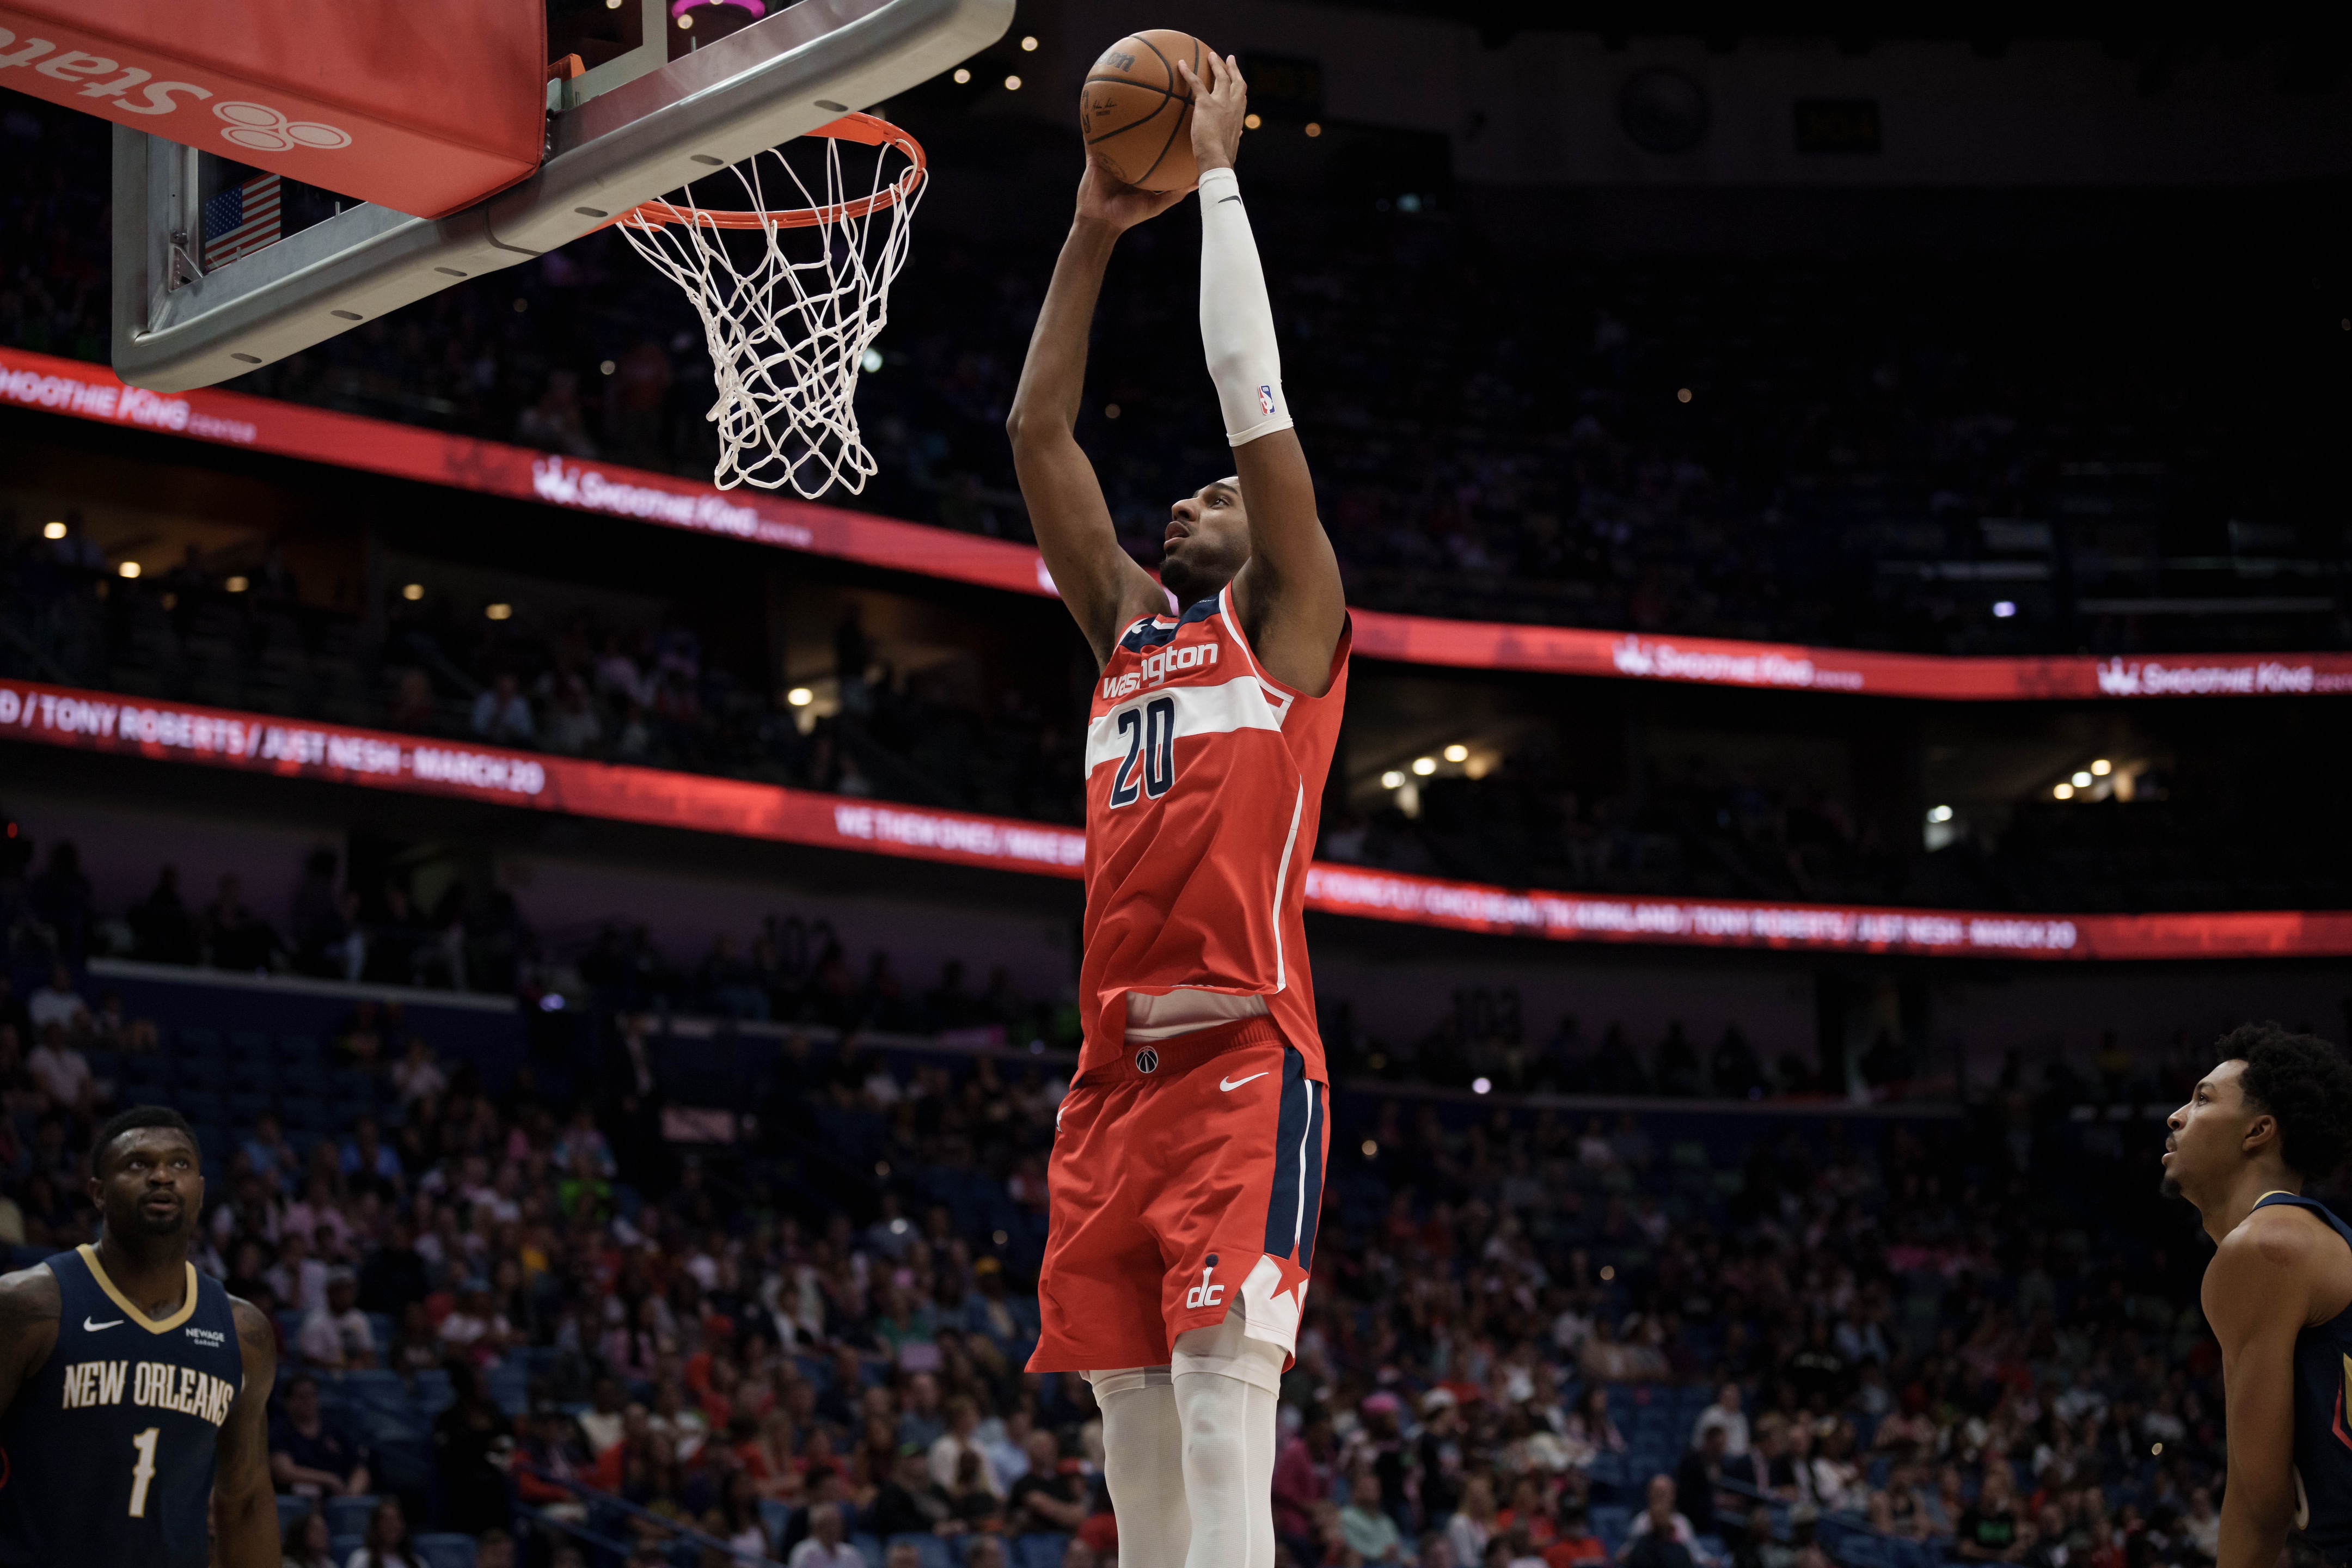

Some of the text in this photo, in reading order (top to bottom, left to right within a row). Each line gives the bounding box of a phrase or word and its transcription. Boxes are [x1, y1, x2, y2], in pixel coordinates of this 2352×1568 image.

[39, 694, 118, 737] TONY
[119, 705, 246, 755] ROBERTS
[1109, 693, 1177, 810] 20
[62, 1359, 234, 1428] NEW ORLEANS
[128, 1427, 160, 1518] 1
